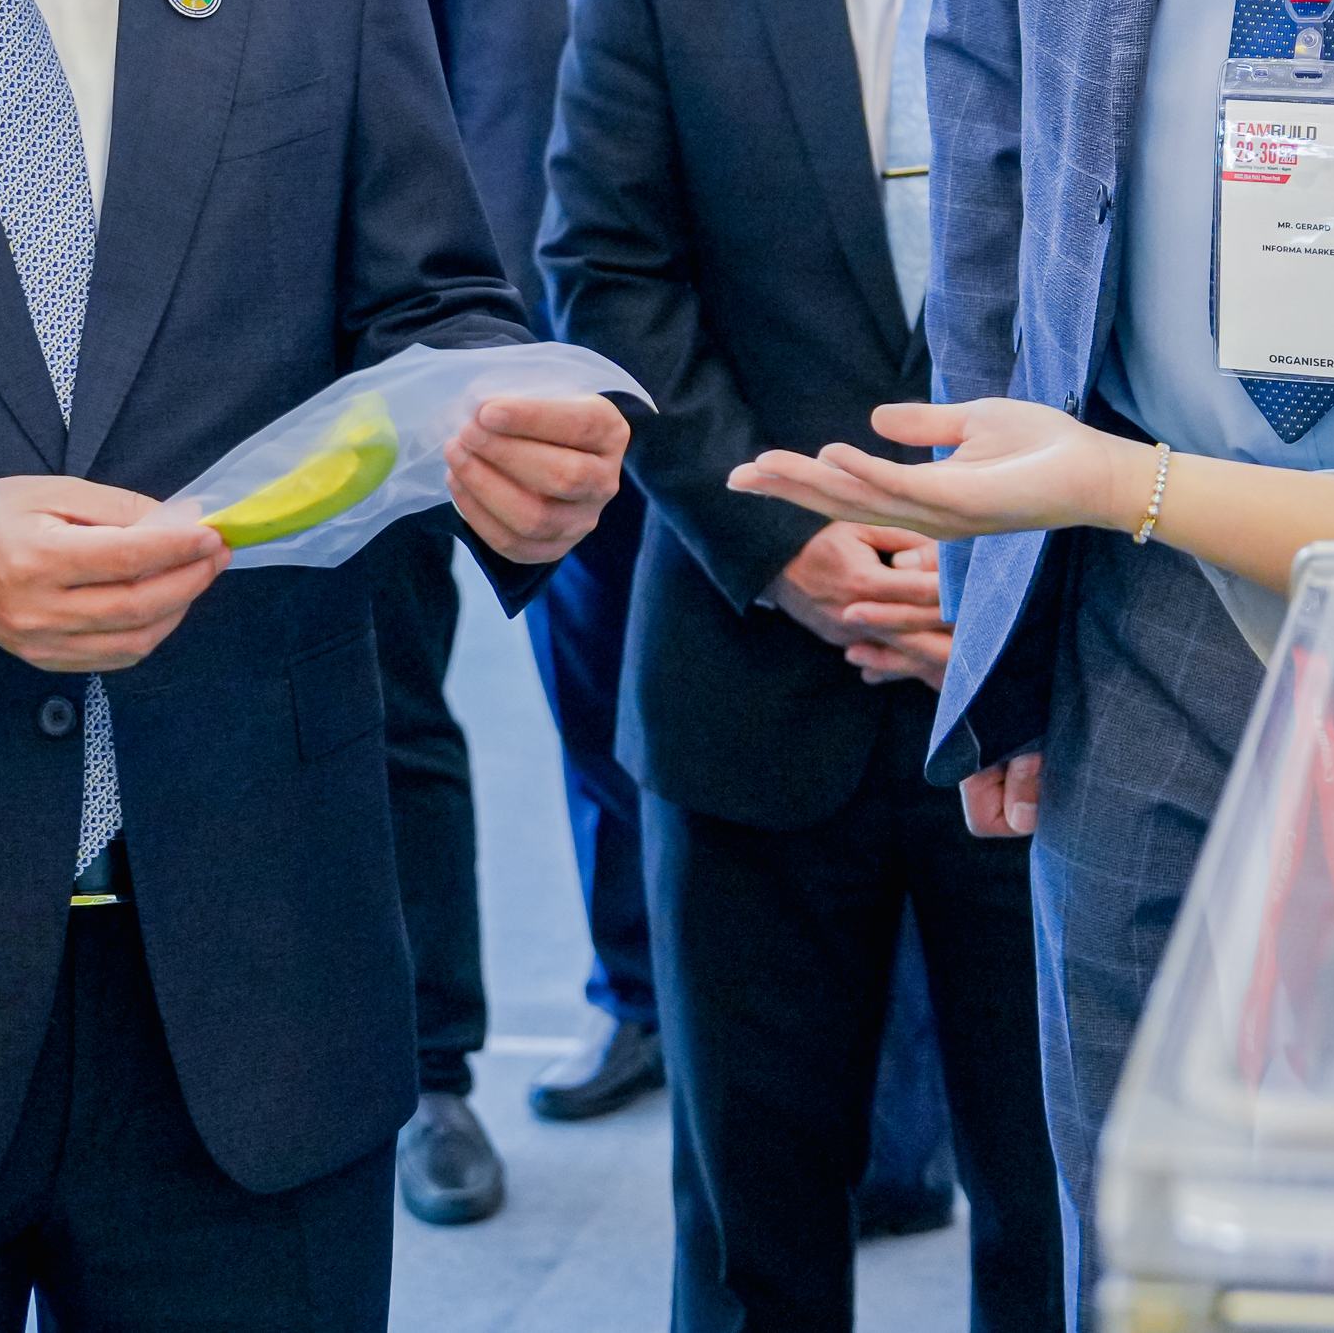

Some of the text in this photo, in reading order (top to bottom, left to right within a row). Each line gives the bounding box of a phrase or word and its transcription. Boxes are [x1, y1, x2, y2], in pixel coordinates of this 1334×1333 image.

[1277, 221, 1331, 232] MR. GERARD
[1262, 244, 1302, 254] INFORMA
[1269, 354, 1334, 368] ORGANISER
